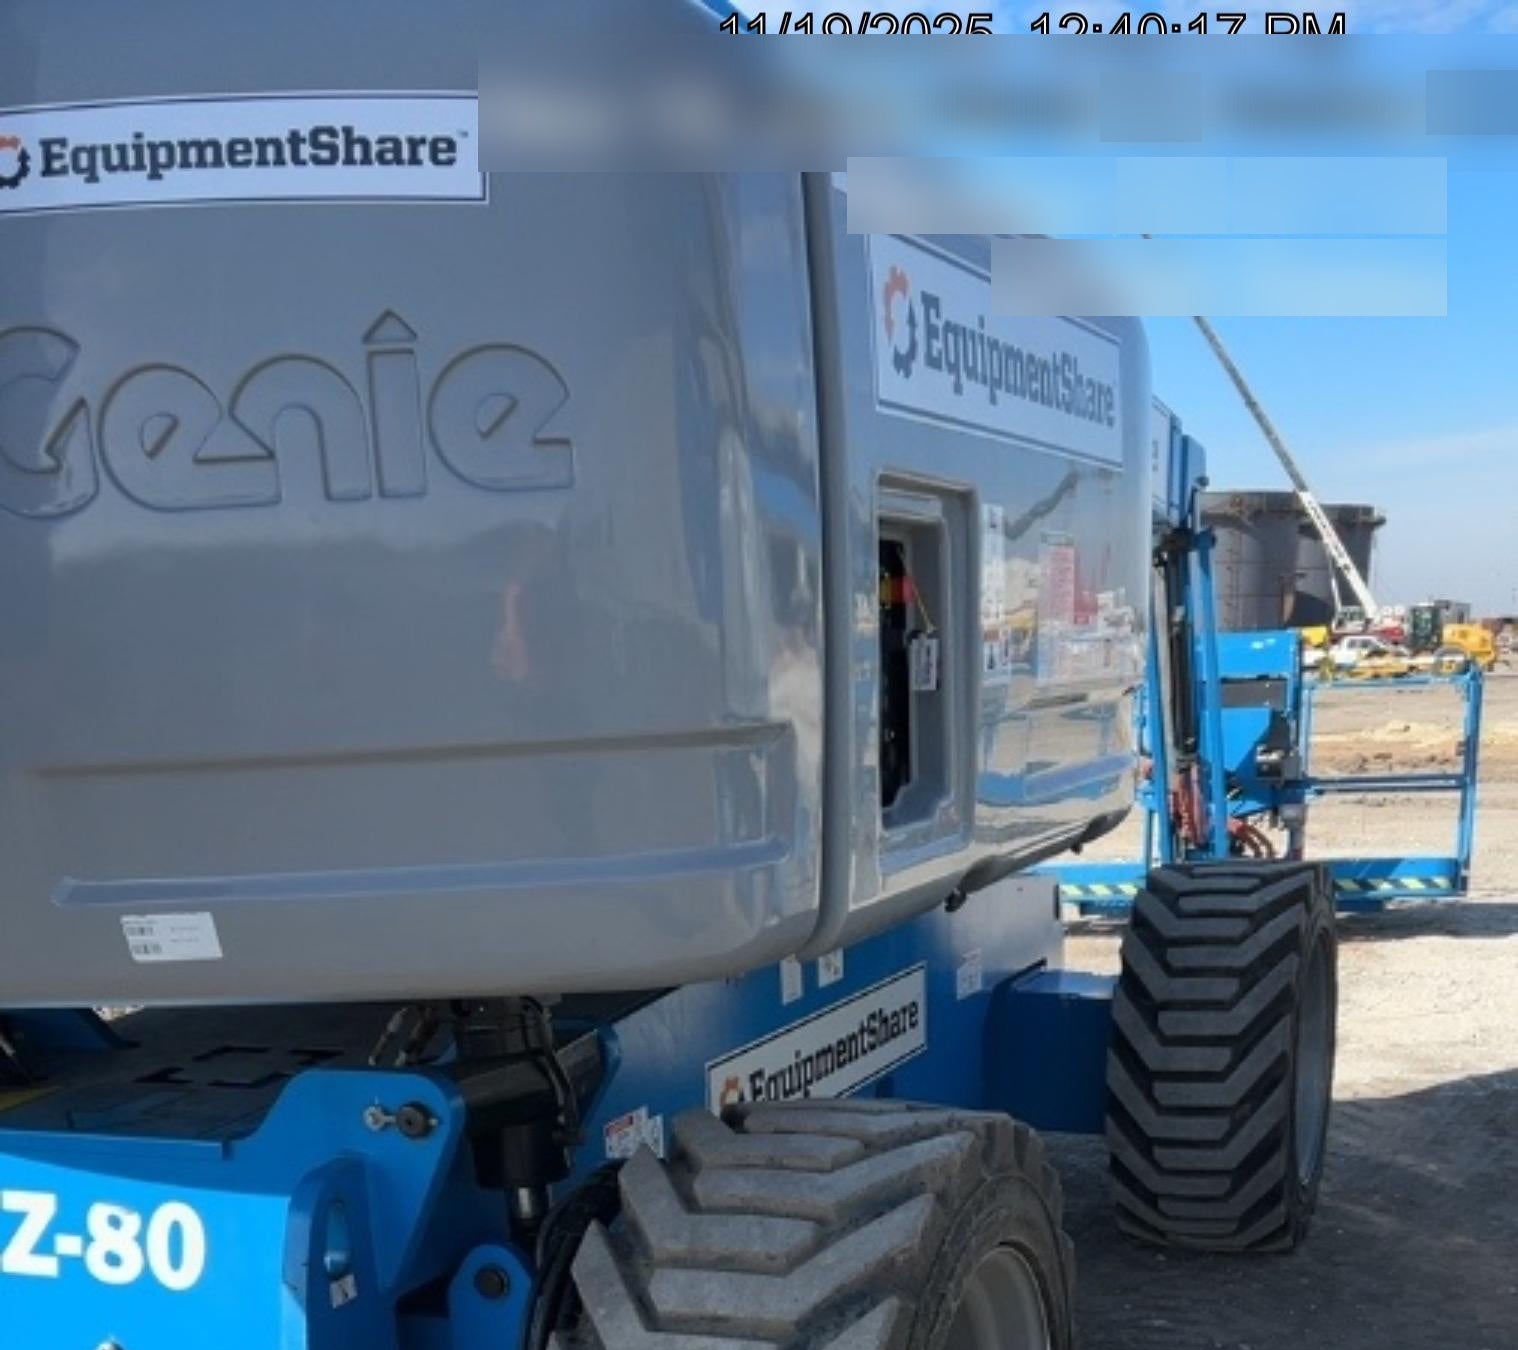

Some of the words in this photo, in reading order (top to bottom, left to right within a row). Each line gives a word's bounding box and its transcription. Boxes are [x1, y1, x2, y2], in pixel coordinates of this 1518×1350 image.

[39, 125, 457, 183] EquipmentShare
[0, 309, 575, 520] Genie
[920, 290, 1116, 428] EquipmentShare
[0, 1189, 205, 1291] Z-80
